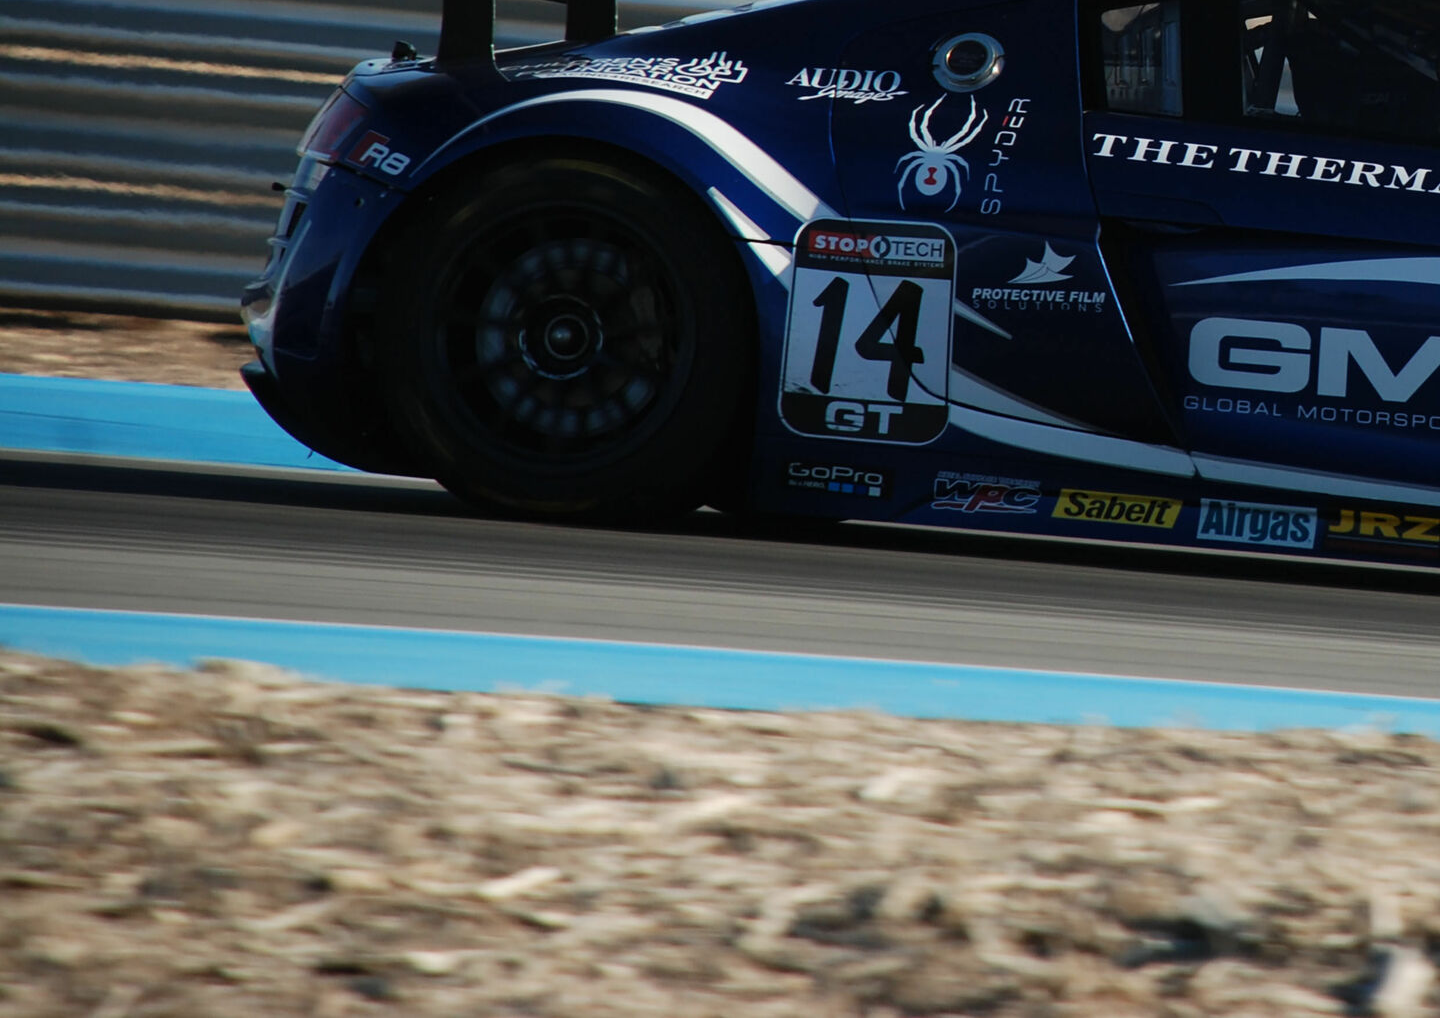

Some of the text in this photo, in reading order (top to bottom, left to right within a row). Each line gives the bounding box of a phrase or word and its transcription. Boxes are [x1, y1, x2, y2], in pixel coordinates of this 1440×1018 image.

[785, 67, 901, 93] AUDIO
[798, 80, 909, 104] Images
[359, 141, 411, 176] R8
[980, 97, 1031, 215] SPYDER
[1092, 132, 1217, 169] THE
[971, 287, 1106, 304] PROTECTIVE FILM
[972, 299, 1103, 313] SOLUTIONS
[809, 275, 925, 404] 14
[824, 400, 904, 435] GT
[1183, 395, 1282, 417] GLOBAL
[788, 462, 884, 486] GoPro
[1063, 491, 1172, 525] Sabelt
[1200, 500, 1311, 543] Airgas
[1327, 508, 1440, 543] JRZ
